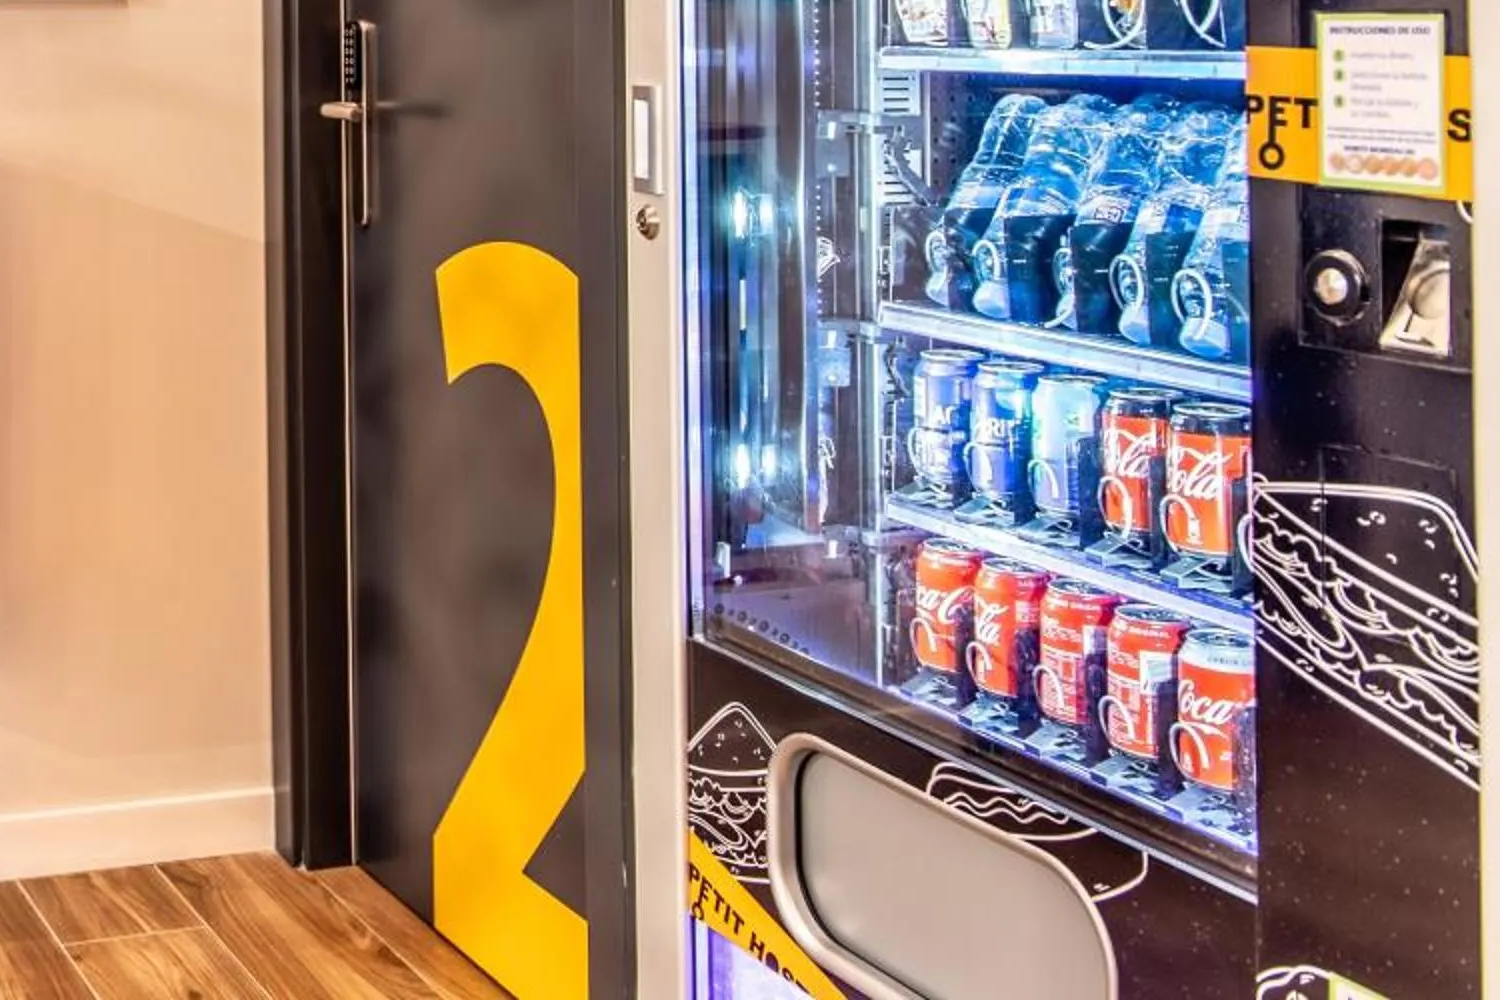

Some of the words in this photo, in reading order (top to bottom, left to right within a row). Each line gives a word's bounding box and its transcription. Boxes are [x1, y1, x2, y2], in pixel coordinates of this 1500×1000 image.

[1329, 25, 1396, 36] INSTRUCCIONES
[1397, 26, 1410, 36] DE
[432, 241, 588, 1000] 2
[1178, 679, 1238, 725] Coca
[688, 862, 745, 936] PETIT
